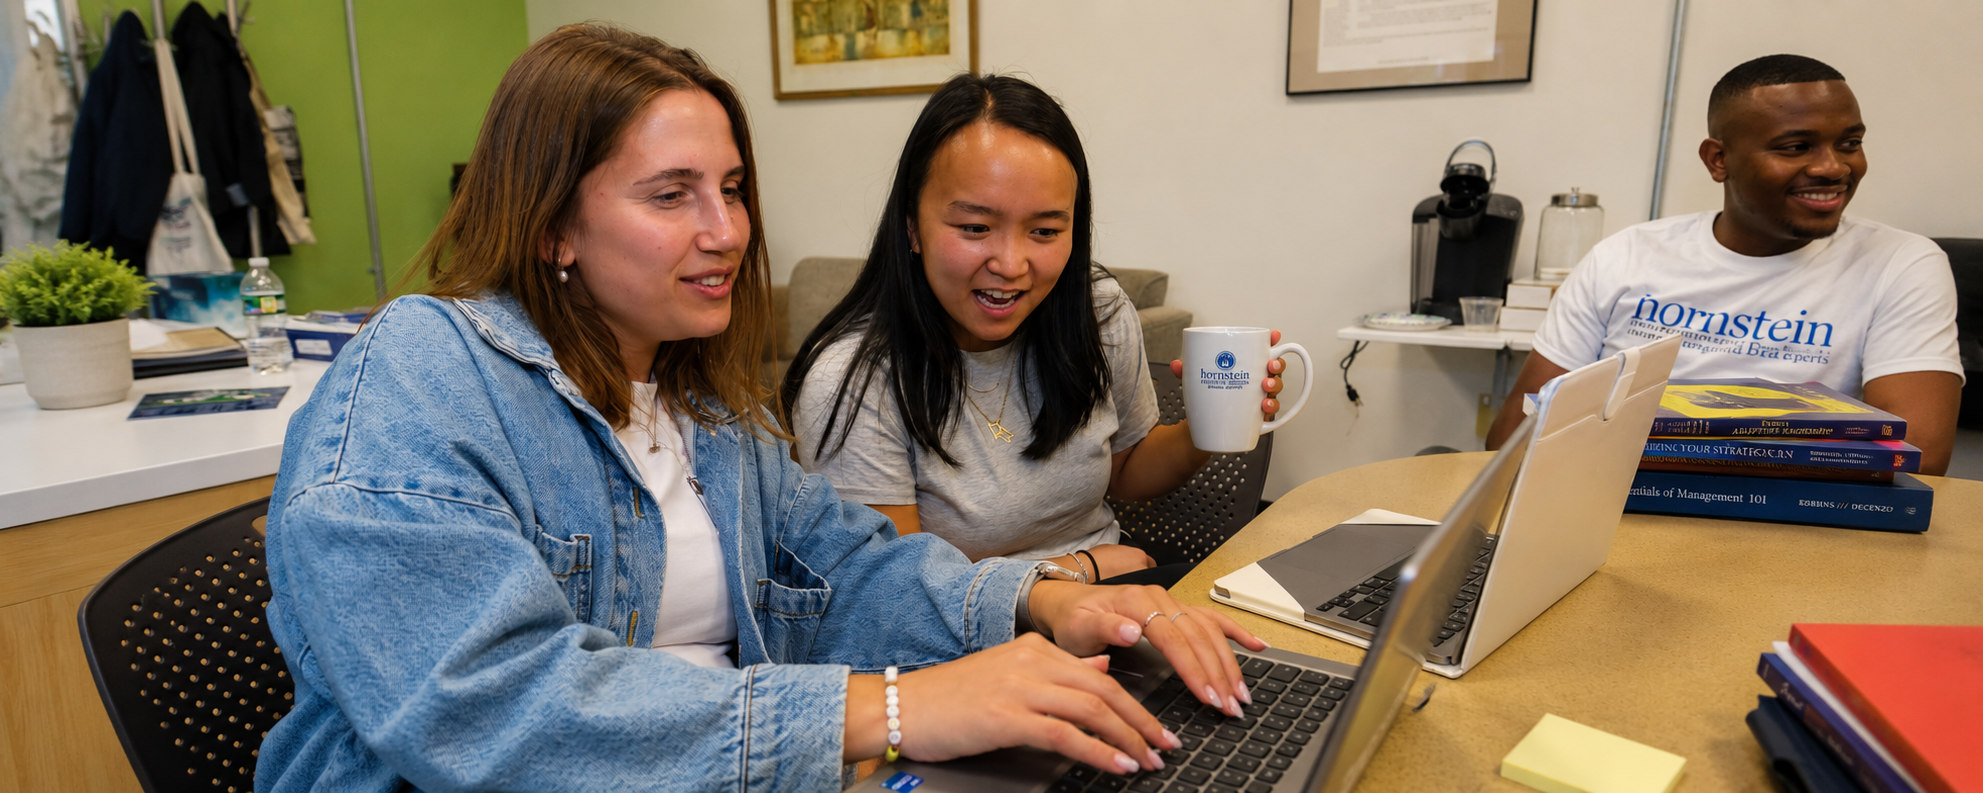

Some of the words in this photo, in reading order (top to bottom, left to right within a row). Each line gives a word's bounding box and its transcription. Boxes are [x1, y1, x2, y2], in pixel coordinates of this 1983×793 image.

[1631, 294, 1834, 348] hornstein
[1200, 368, 1250, 380] hornstein
[1680, 443, 1711, 454] YOUR
[1662, 487, 1675, 498] of
[1676, 488, 1744, 503] Management
[1749, 494, 1767, 505] 101
